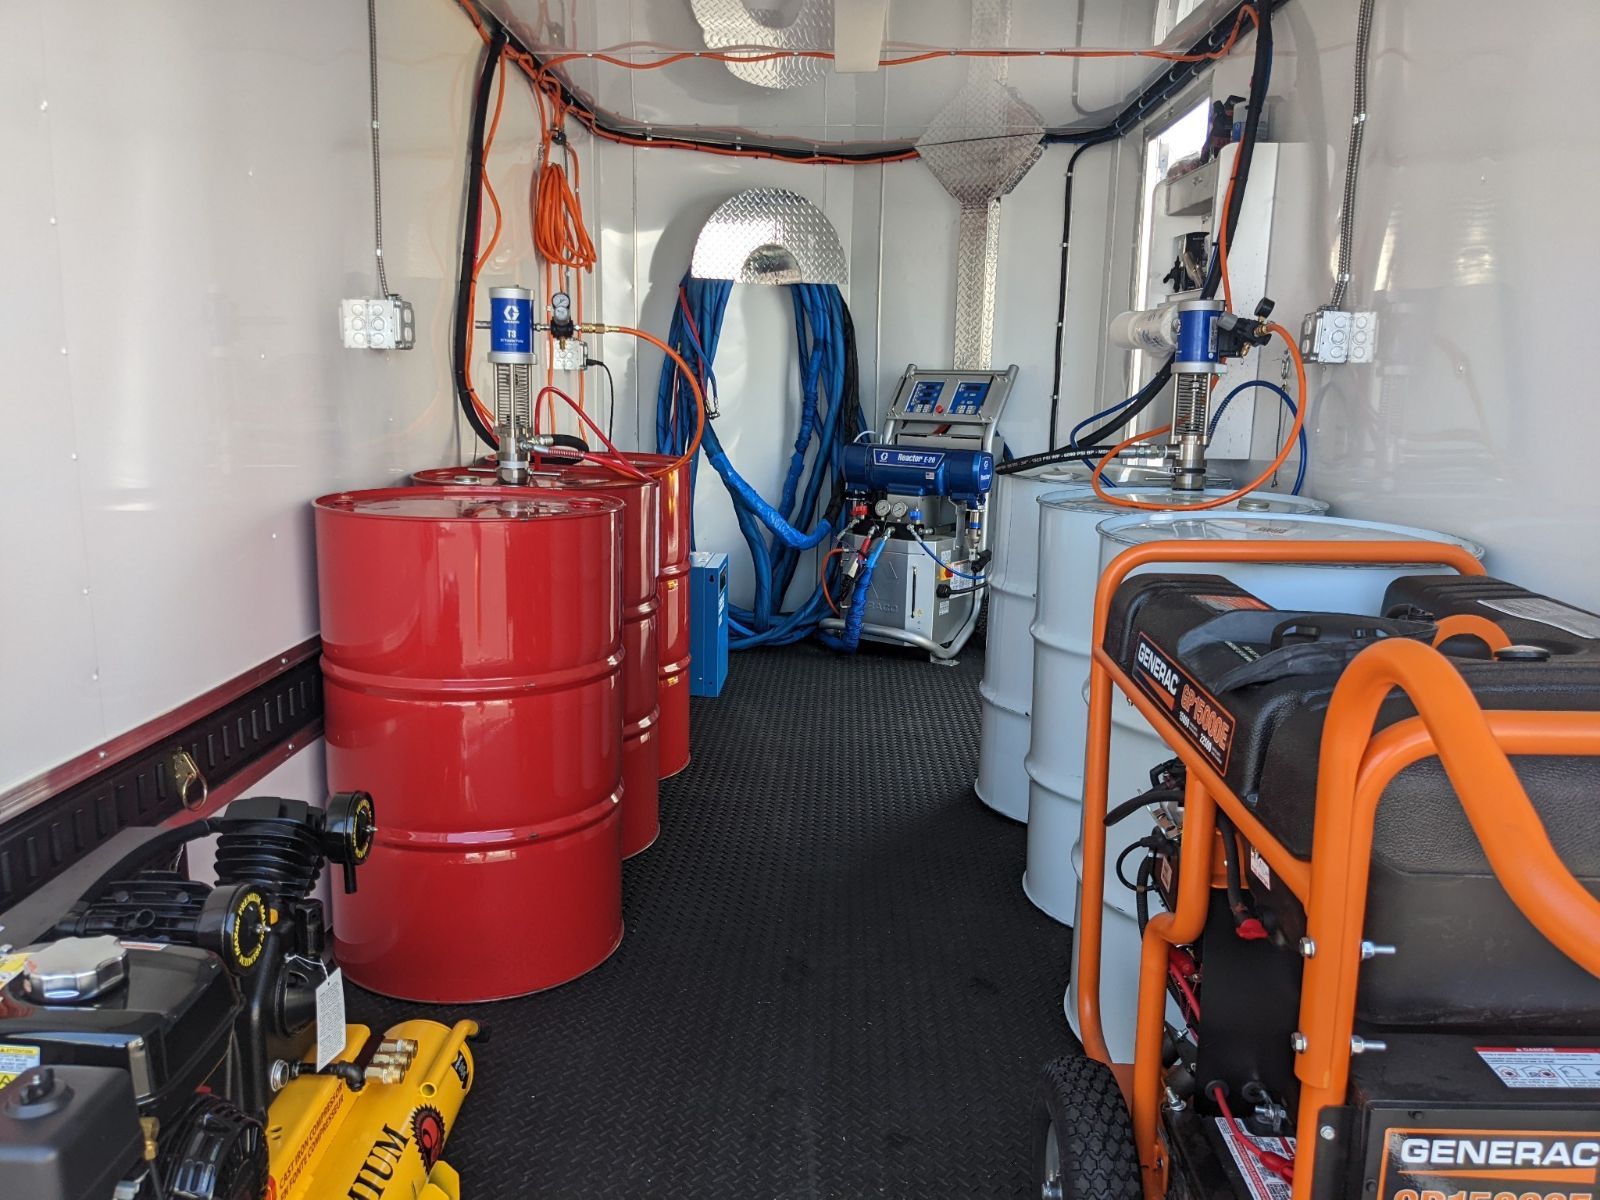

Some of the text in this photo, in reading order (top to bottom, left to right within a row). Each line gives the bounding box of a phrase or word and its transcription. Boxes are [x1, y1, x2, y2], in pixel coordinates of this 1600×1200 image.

[507, 329, 517, 339] T3
[897, 453, 923, 463] Reactor
[1138, 642, 1179, 696] GENERAC
[1180, 684, 1230, 751] GP15000E
[279, 1161, 295, 1189] CAST
[295, 1137, 309, 1165] IRON
[309, 1081, 343, 1140] COMPRESSOR
[290, 1155, 308, 1190] FONTE
[308, 1094, 344, 1158] COMPRESSEUR
[1400, 1138, 1600, 1167] GENERAC
